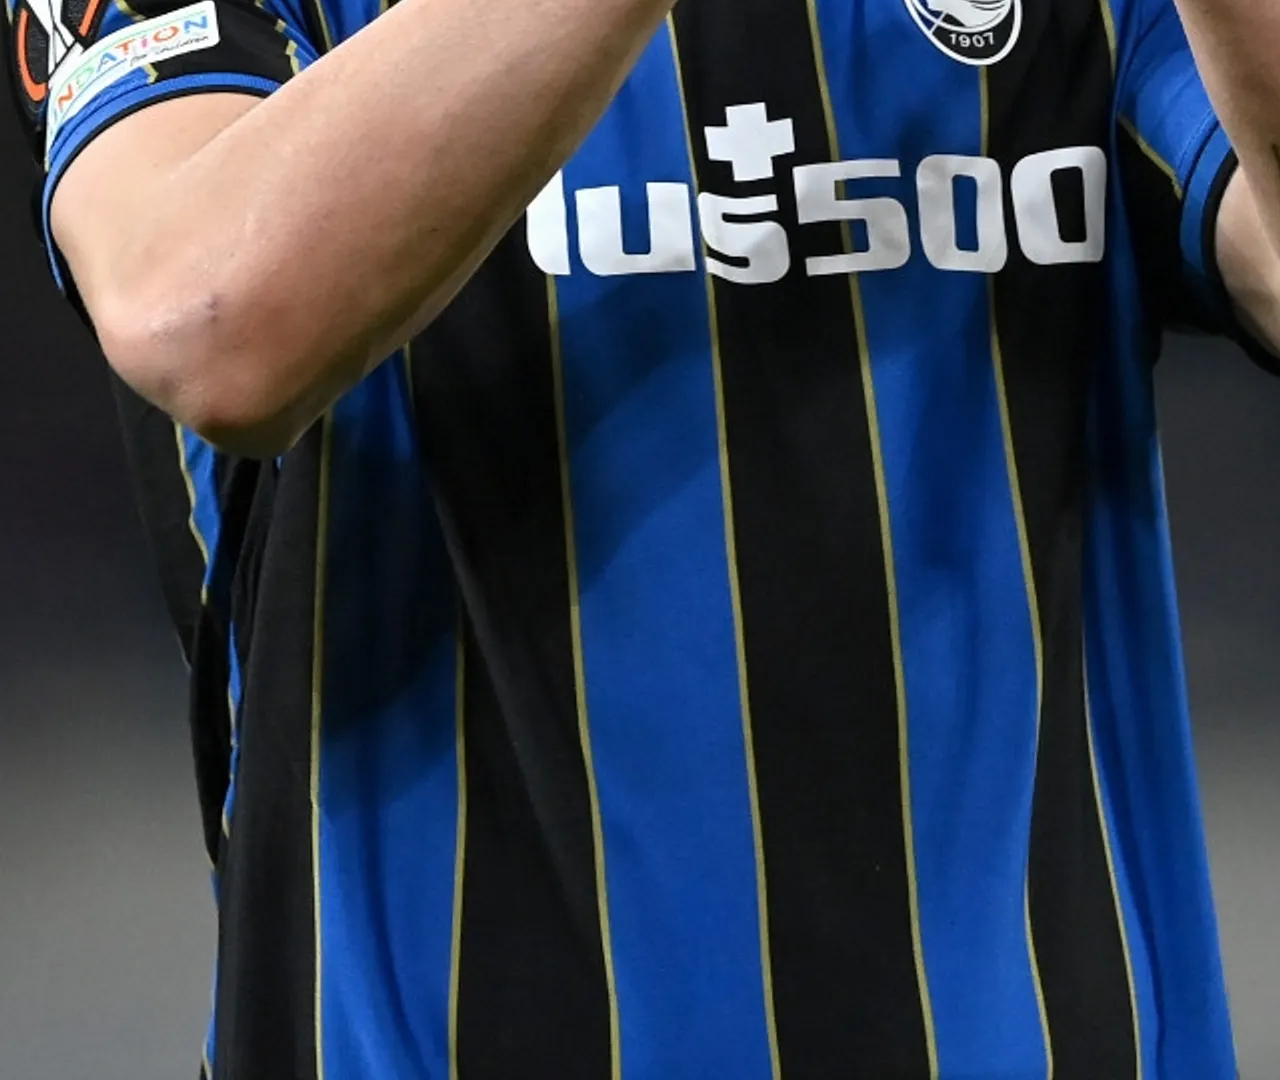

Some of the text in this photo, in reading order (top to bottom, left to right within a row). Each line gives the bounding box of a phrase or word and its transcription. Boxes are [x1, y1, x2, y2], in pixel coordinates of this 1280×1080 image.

[56, 15, 210, 111] NDATION
[949, 32, 995, 47] 1907
[526, 146, 1107, 284] lus500
